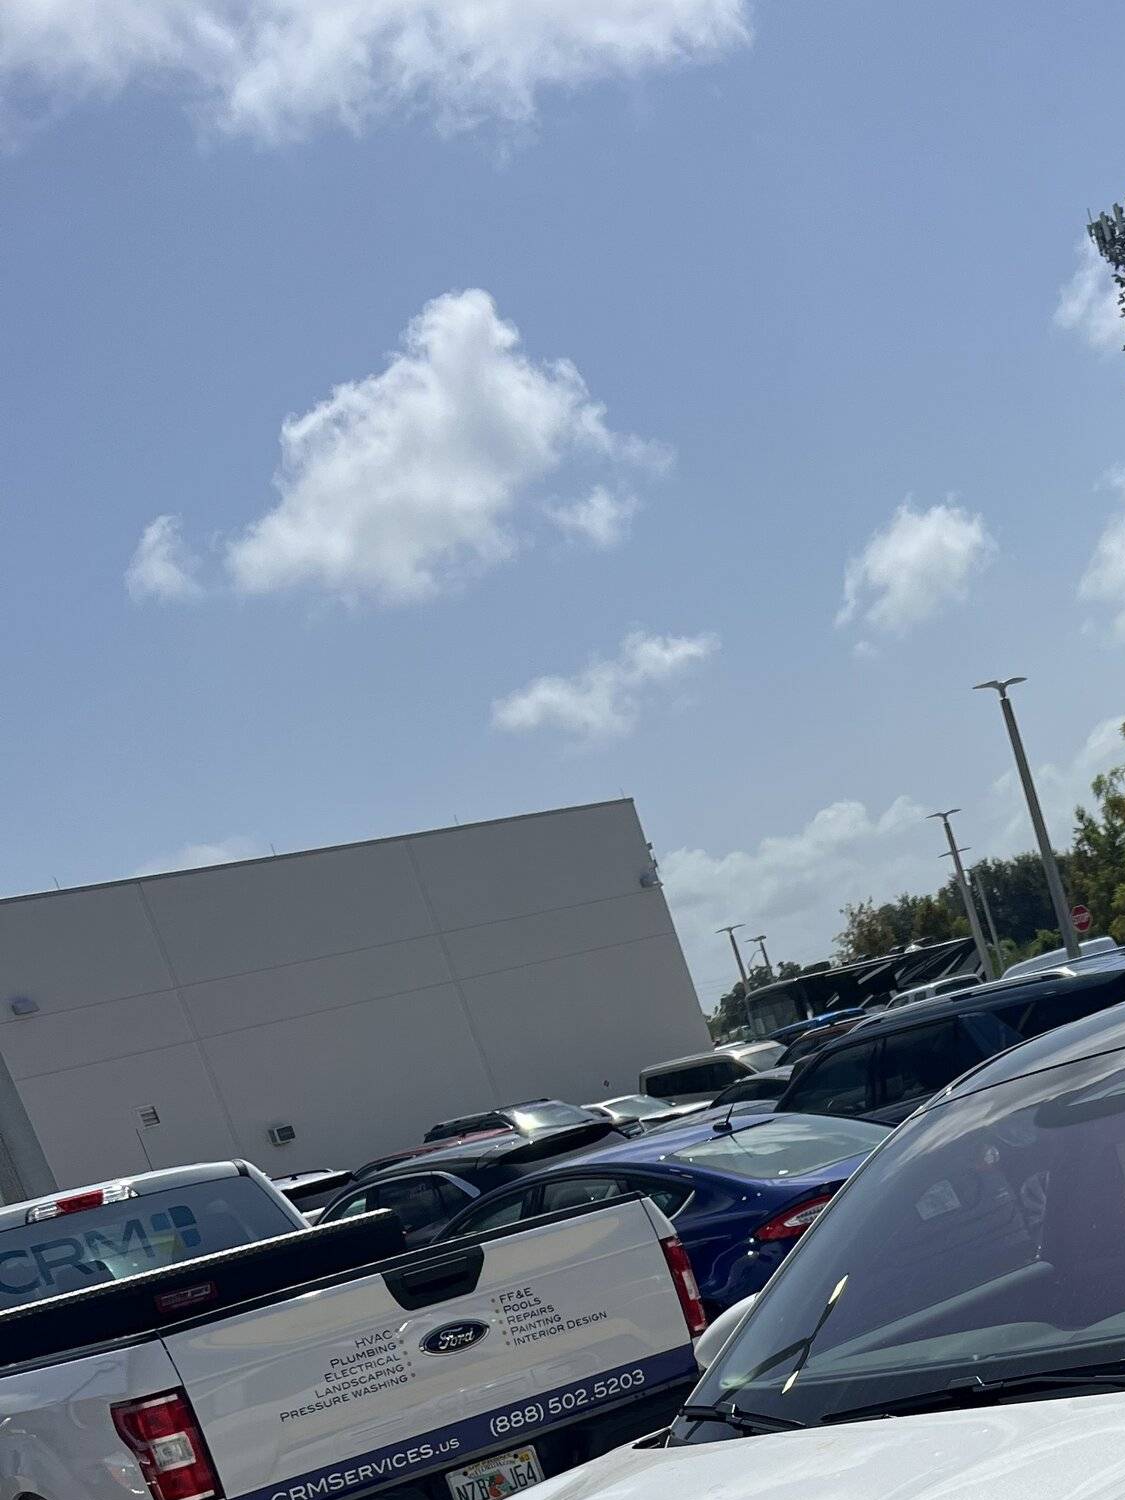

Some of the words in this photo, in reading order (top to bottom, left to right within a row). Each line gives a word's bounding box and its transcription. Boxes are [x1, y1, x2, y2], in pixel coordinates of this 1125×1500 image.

[0, 1218, 156, 1295] CRM
[498, 1287, 534, 1304] FF&E
[503, 1297, 541, 1314] POOLS
[506, 1304, 555, 1325] REPAIRS
[510, 1314, 562, 1336] PAINTING
[513, 1324, 565, 1346] INTERIOR
[566, 1311, 608, 1330] DESIGN
[355, 1329, 393, 1349] HVAC
[438, 1327, 474, 1350] Ford
[324, 1353, 401, 1383] ELECTRICAL
[330, 1342, 397, 1369] PLUMBING
[315, 1364, 405, 1399] LANDSCAPING
[279, 1393, 351, 1422] PRESSURE
[351, 1374, 408, 1399] WASHING
[489, 1402, 545, 1437] (888)
[548, 1368, 645, 1415] 502.5203
[509, 1460, 538, 1491] J64
